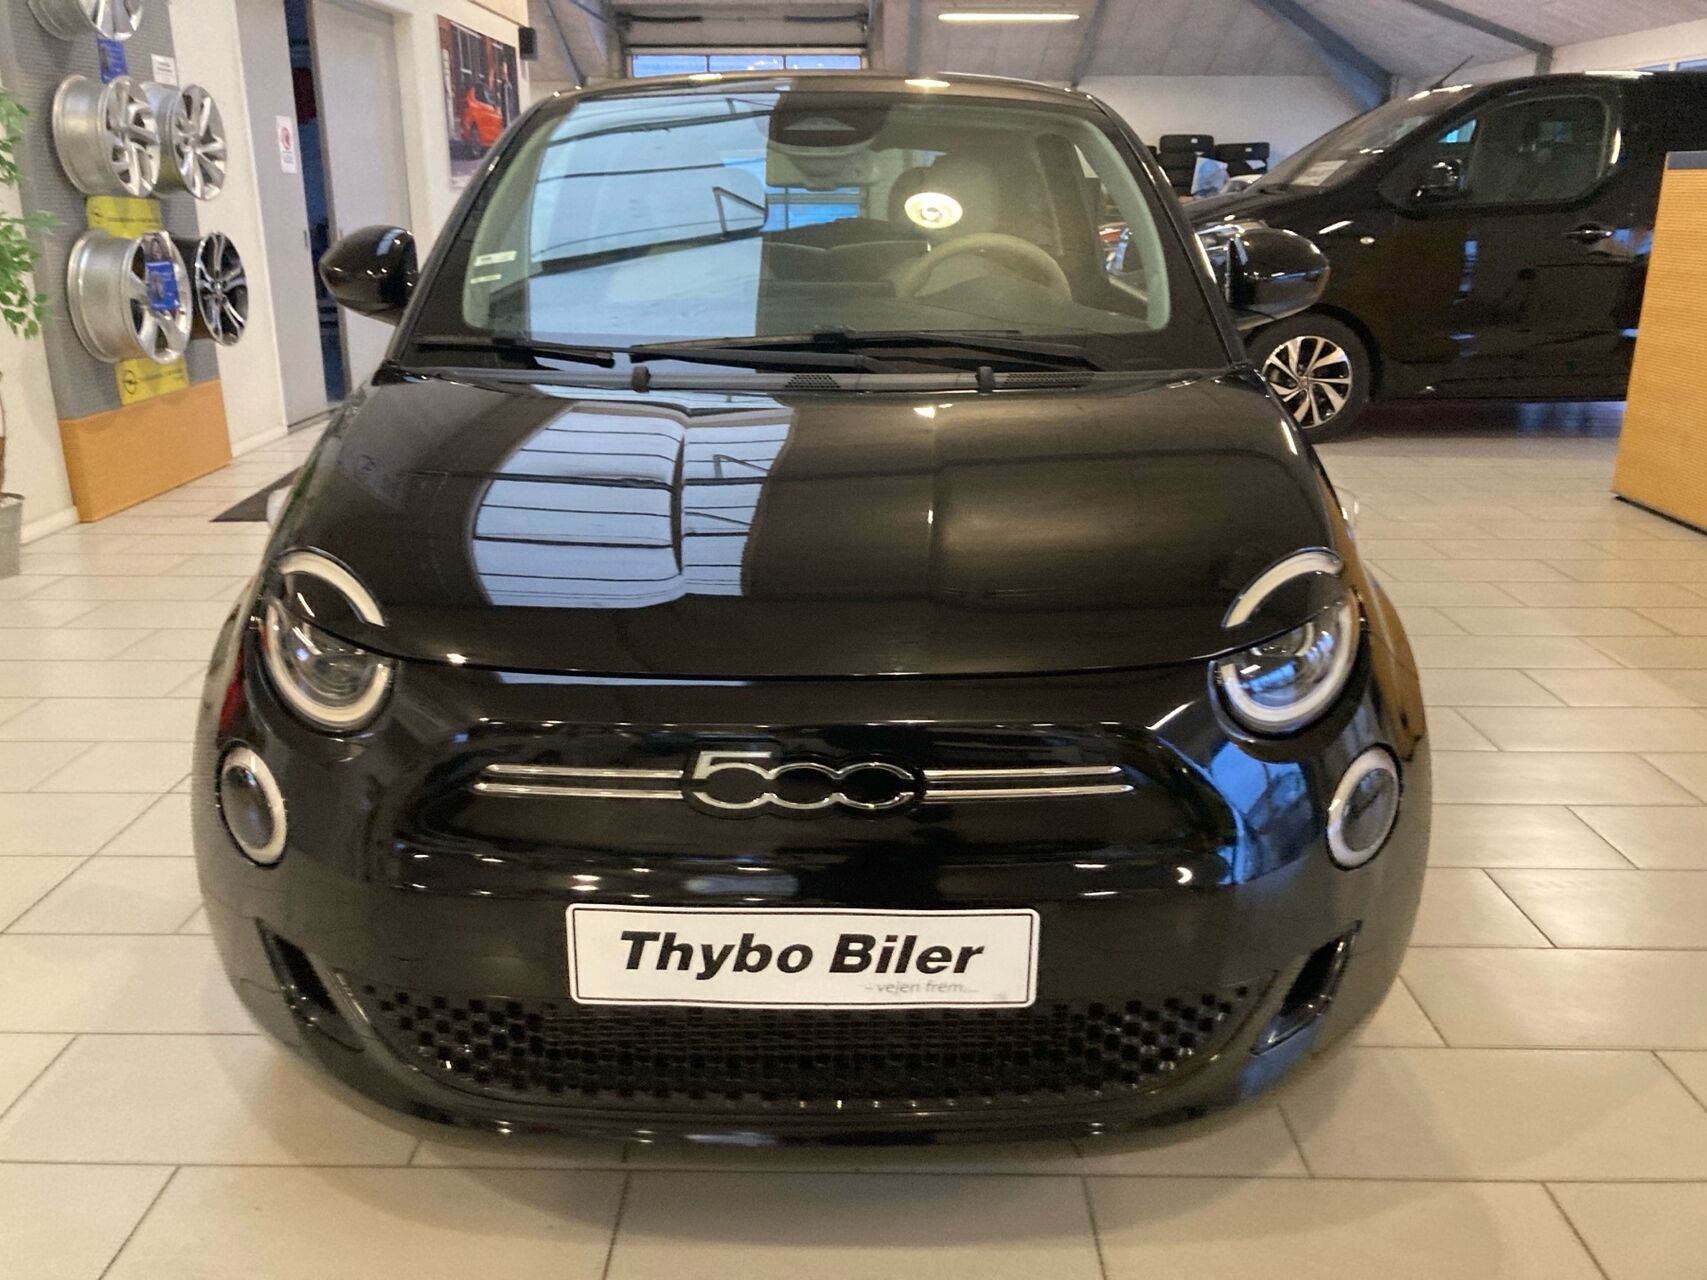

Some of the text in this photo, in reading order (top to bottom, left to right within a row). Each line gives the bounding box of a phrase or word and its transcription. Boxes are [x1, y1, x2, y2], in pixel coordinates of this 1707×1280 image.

[693, 750, 916, 809] 500
[620, 931, 984, 980] Thybo Biler
[876, 981, 920, 993] vejen
